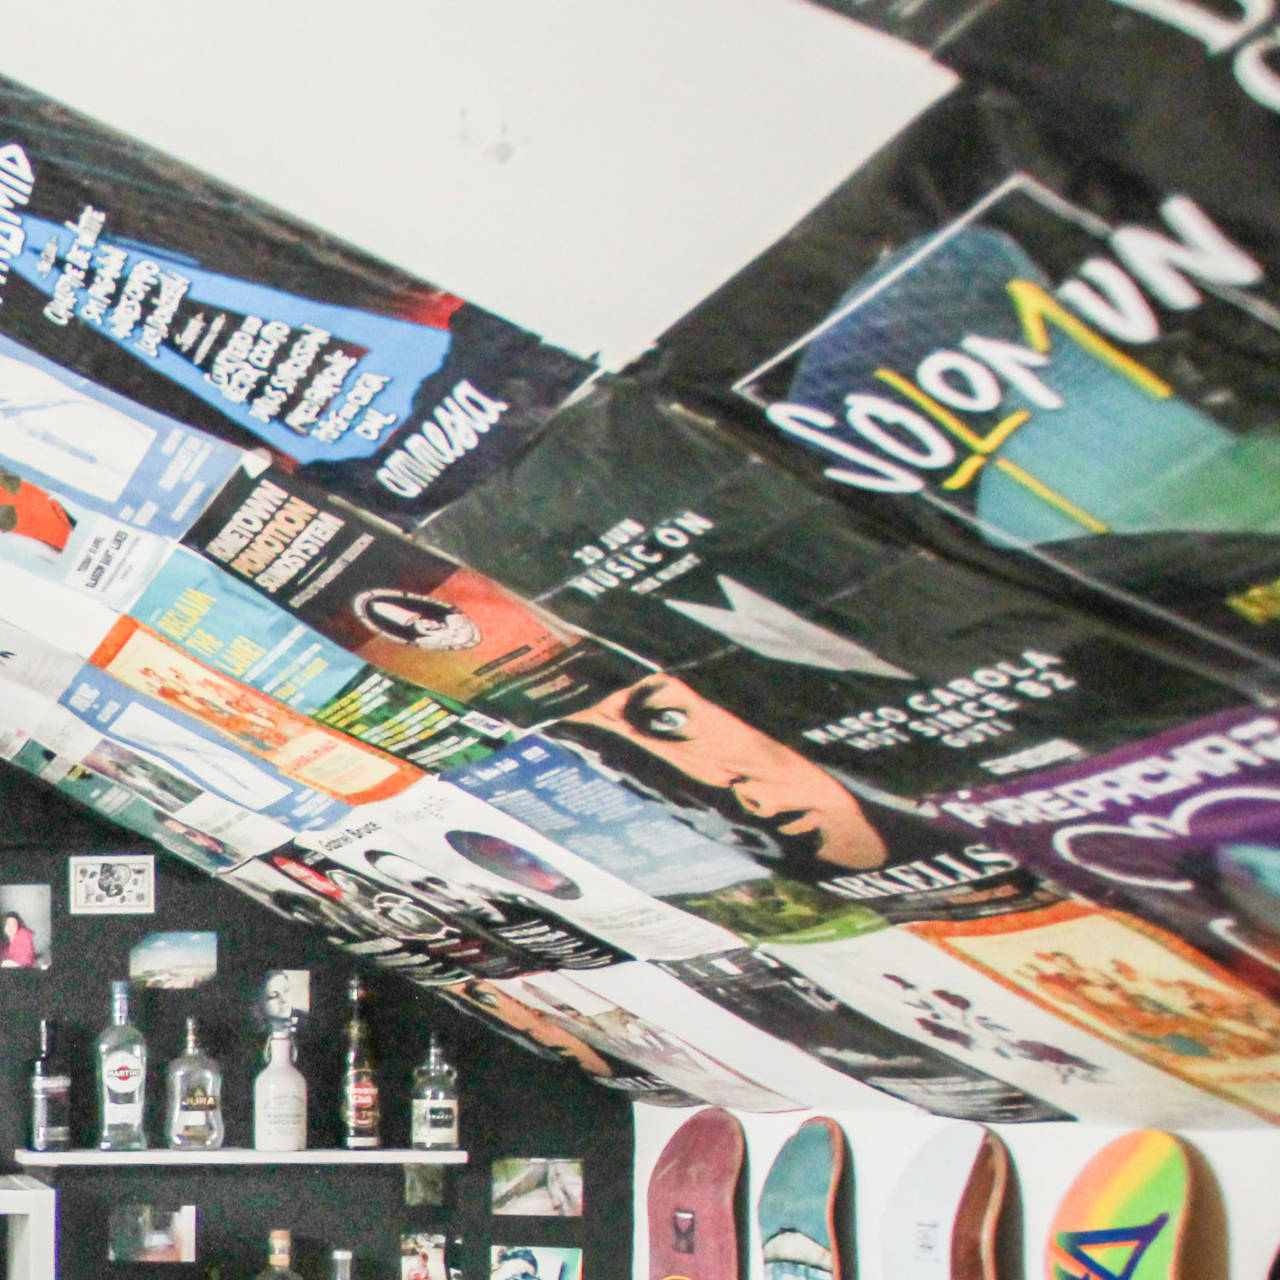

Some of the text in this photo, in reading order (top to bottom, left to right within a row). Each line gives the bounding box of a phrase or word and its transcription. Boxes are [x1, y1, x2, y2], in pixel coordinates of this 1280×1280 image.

[766, 196, 1264, 493] SOLOMUN
[375, 380, 509, 499] amnesia
[568, 511, 714, 597] MUSIC ON
[802, 651, 1061, 744] MARCO CAROLA
[909, 693, 1019, 737] SINCE
[181, 1096, 215, 1105] JURA
